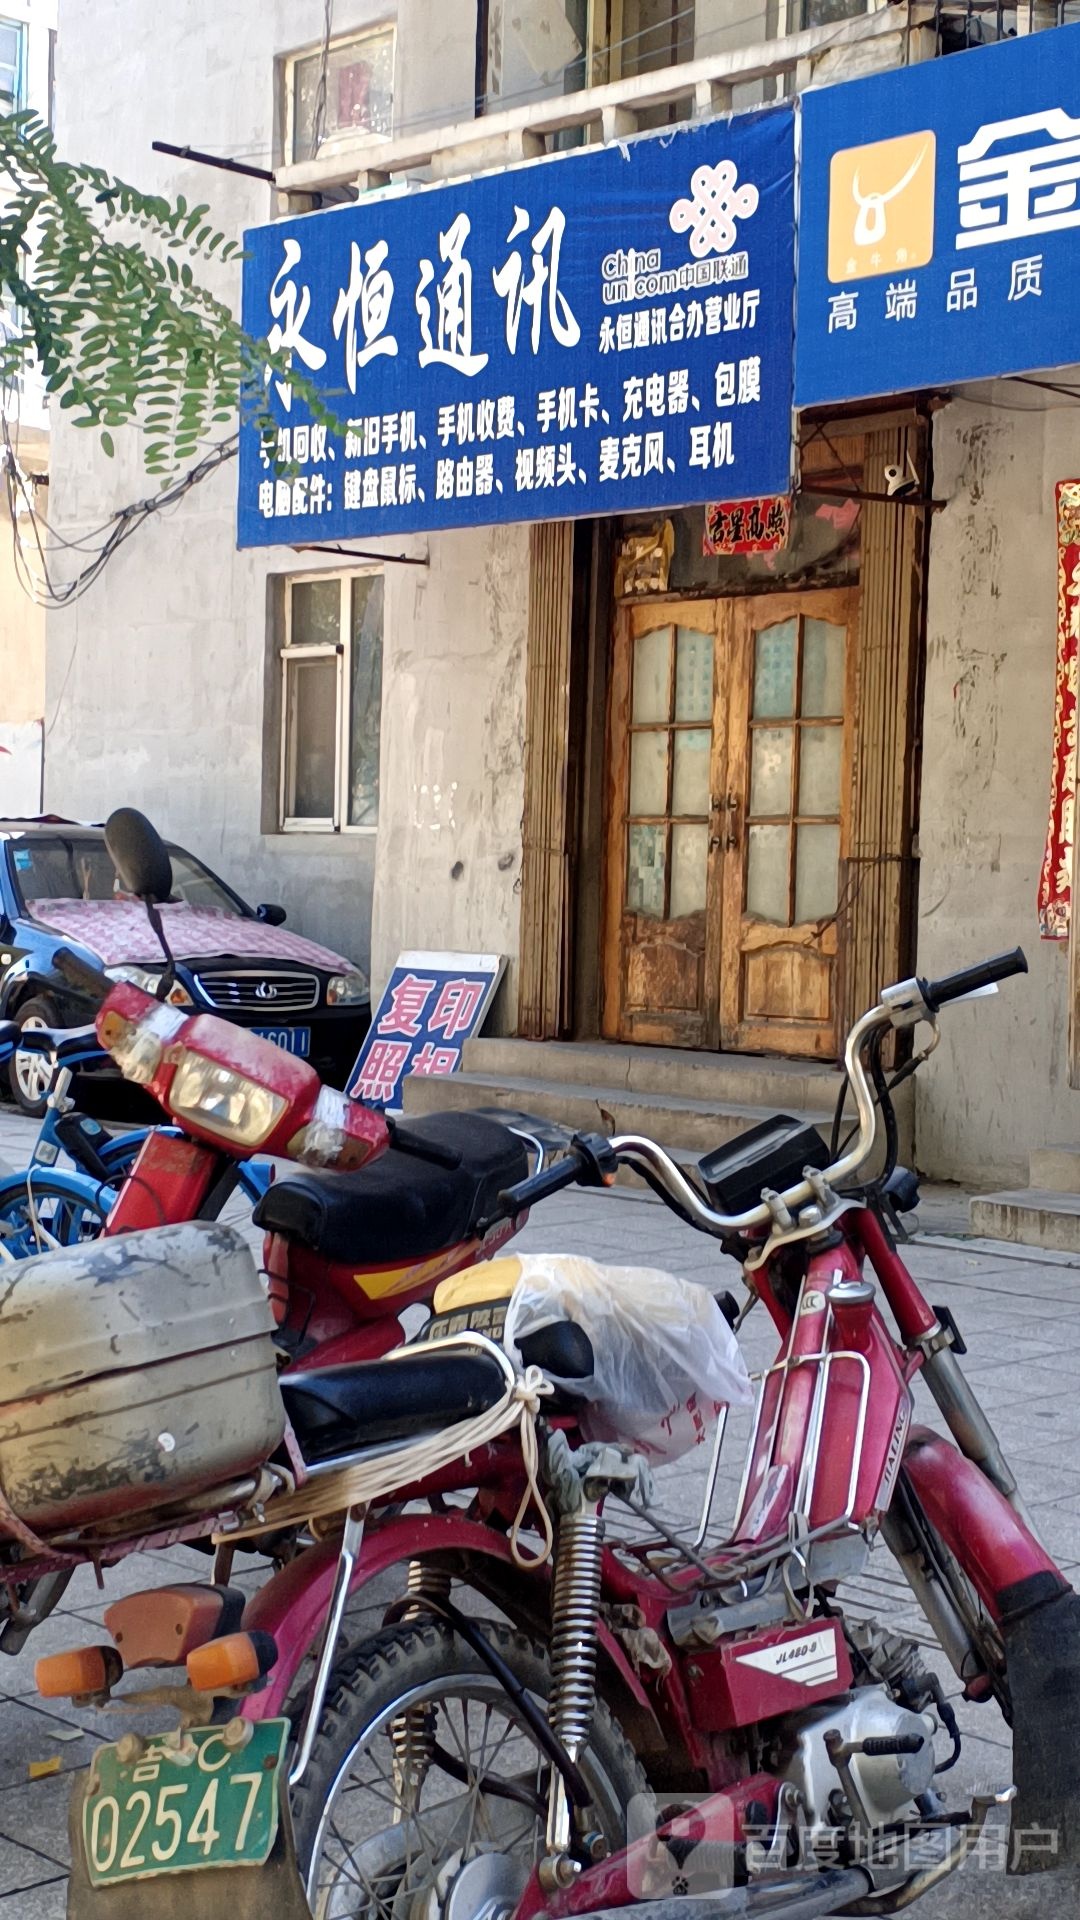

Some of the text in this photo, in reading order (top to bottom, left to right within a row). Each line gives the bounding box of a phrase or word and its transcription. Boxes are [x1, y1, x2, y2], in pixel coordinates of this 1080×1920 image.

[955, 107, 1080, 250] 金
[602, 247, 661, 281] China
[827, 254, 1043, 334] 高端品质
[264, 206, 580, 412] 永恒通讯
[599, 289, 760, 354] 永恒通讯合办营业厅
[709, 503, 784, 544] 吉星高照
[378, 973, 486, 1039] 复印
[91, 1772, 263, 1872] 02547
